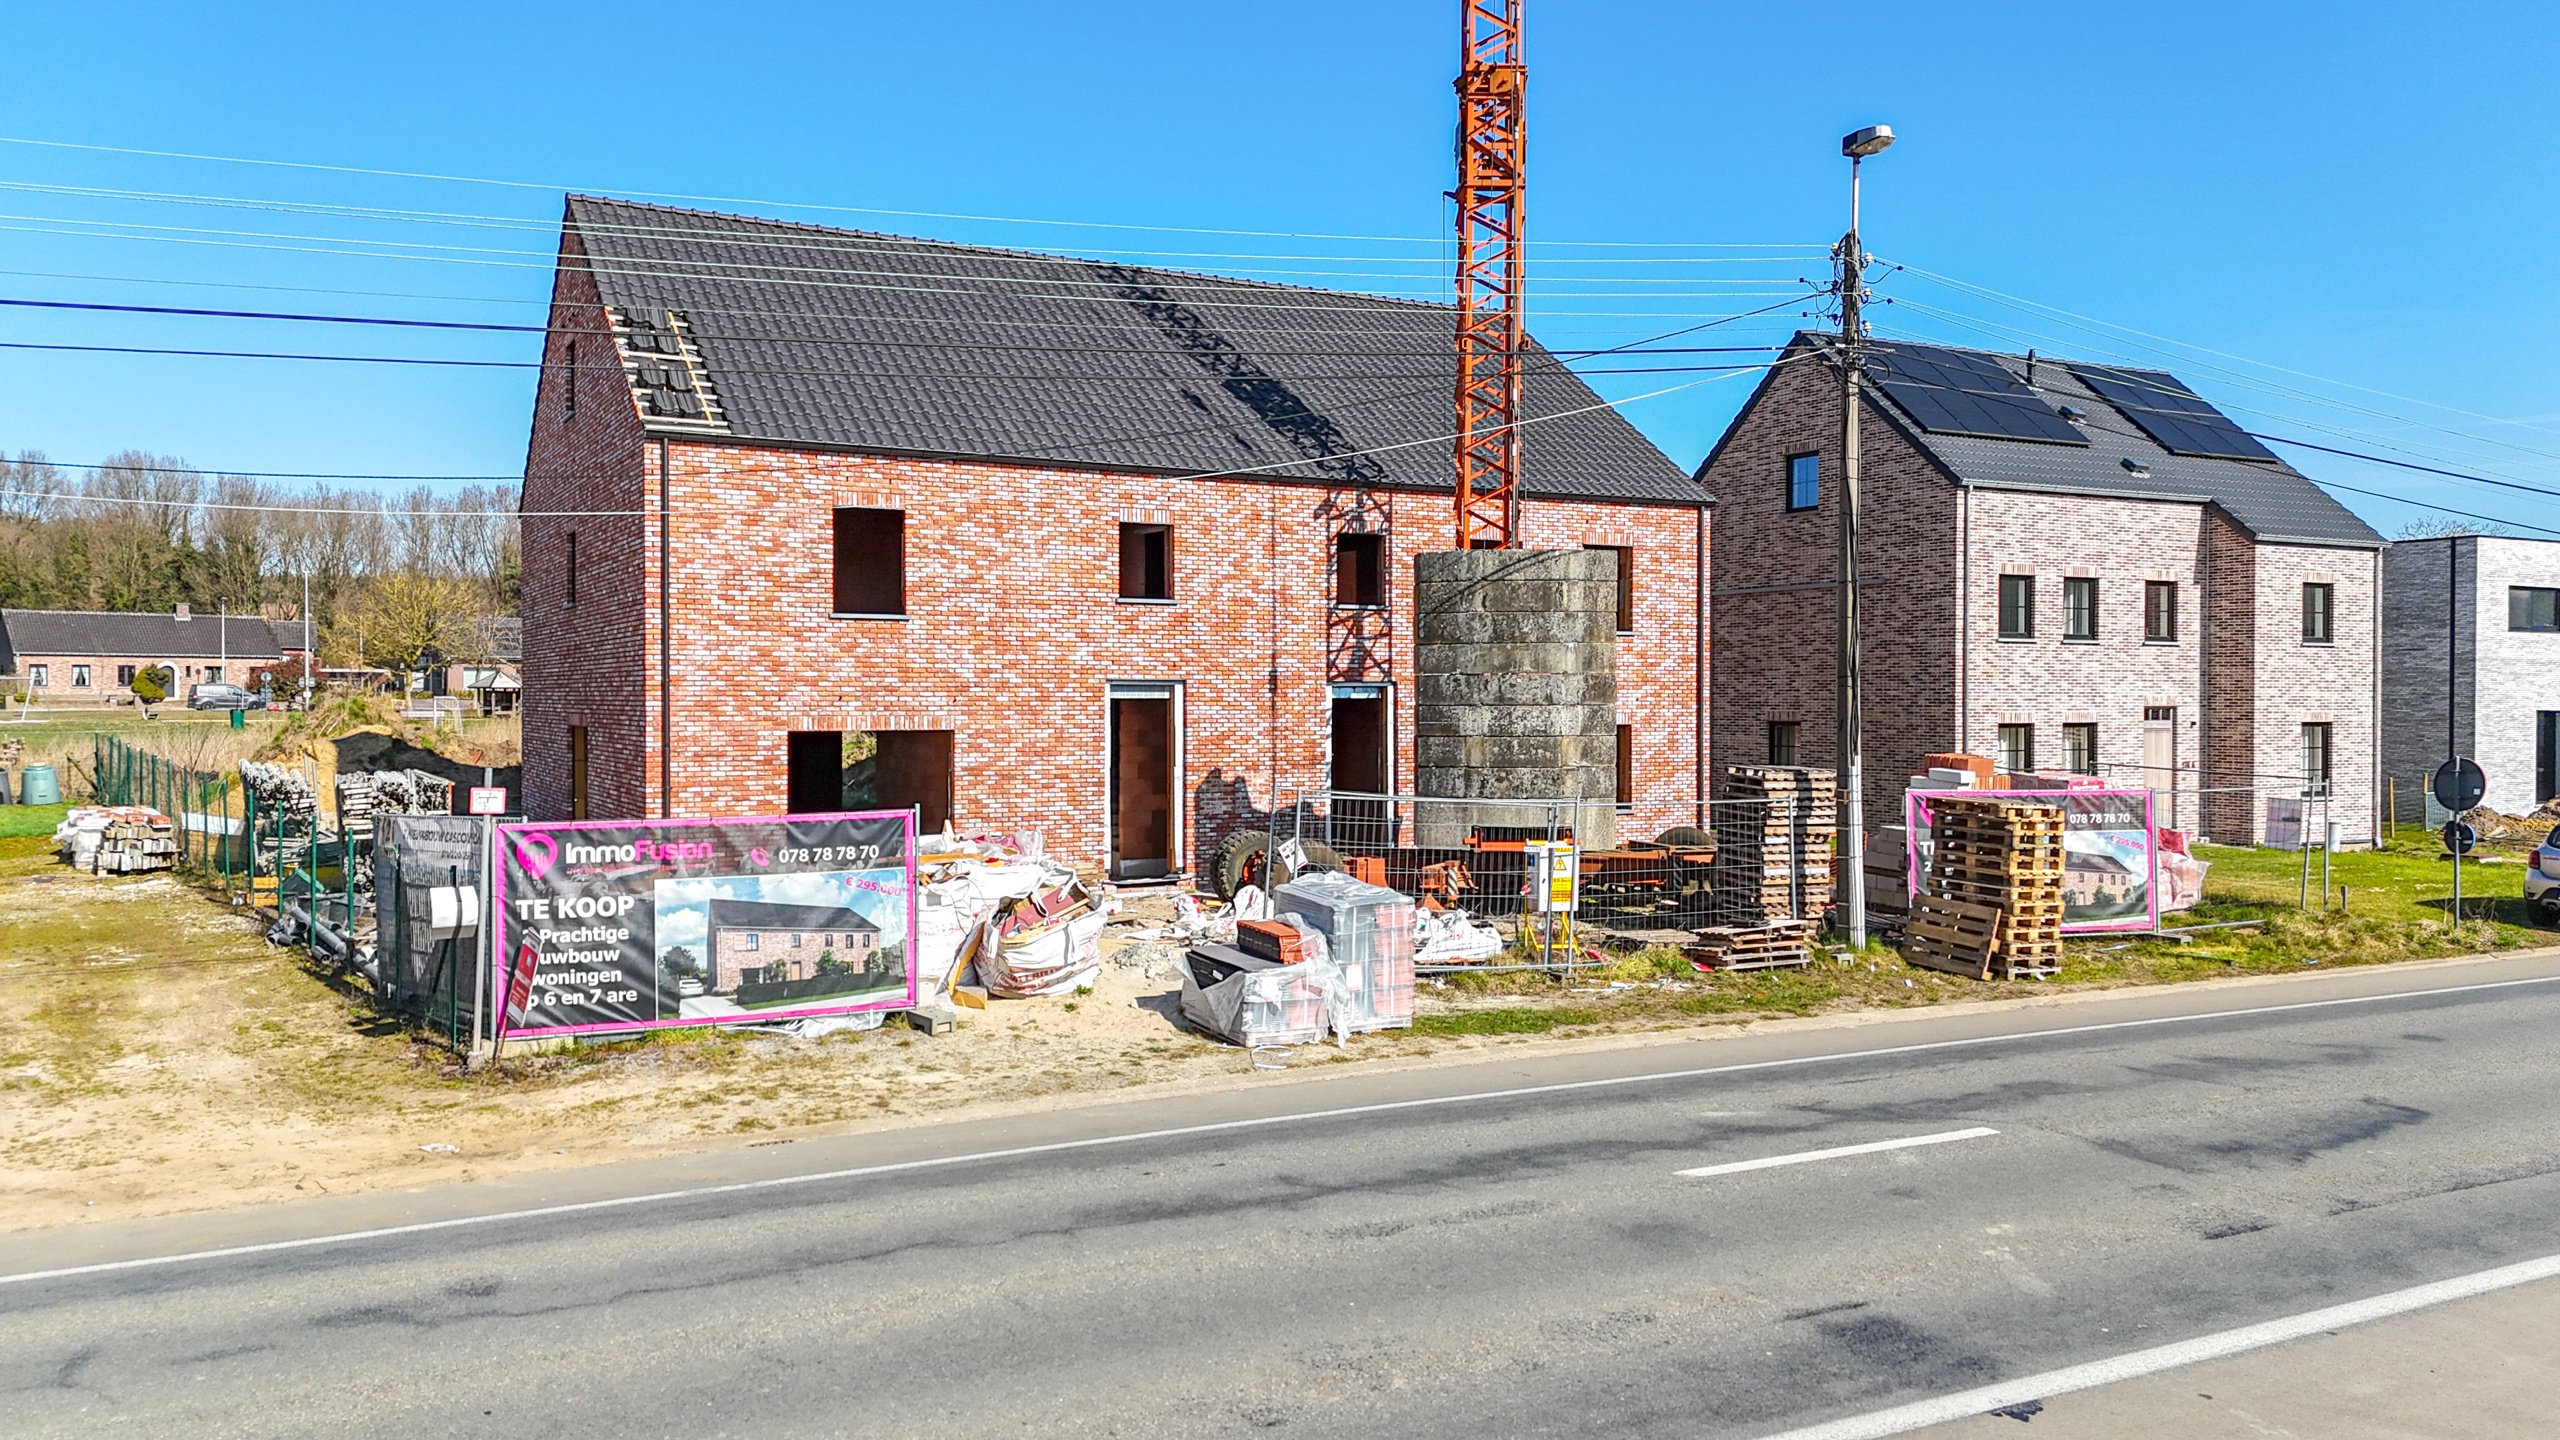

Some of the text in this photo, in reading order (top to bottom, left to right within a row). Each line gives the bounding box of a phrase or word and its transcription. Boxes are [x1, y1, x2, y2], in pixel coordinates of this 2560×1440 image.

[2069, 813, 2131, 824] 078 78 78 70
[565, 838, 714, 864] ImmoFusion
[778, 845, 880, 864] 078 78 78 70
[1924, 861, 1932, 872] 2
[845, 876, 902, 897] € 295.000
[515, 895, 635, 920] TE KOOP
[540, 926, 630, 944] Prachtige
[540, 949, 621, 965] uwbouw
[527, 994, 539, 1010] p
[544, 992, 556, 1006] 6
[561, 992, 585, 1005] en
[590, 989, 602, 1003] 7
[607, 989, 638, 1003] are
